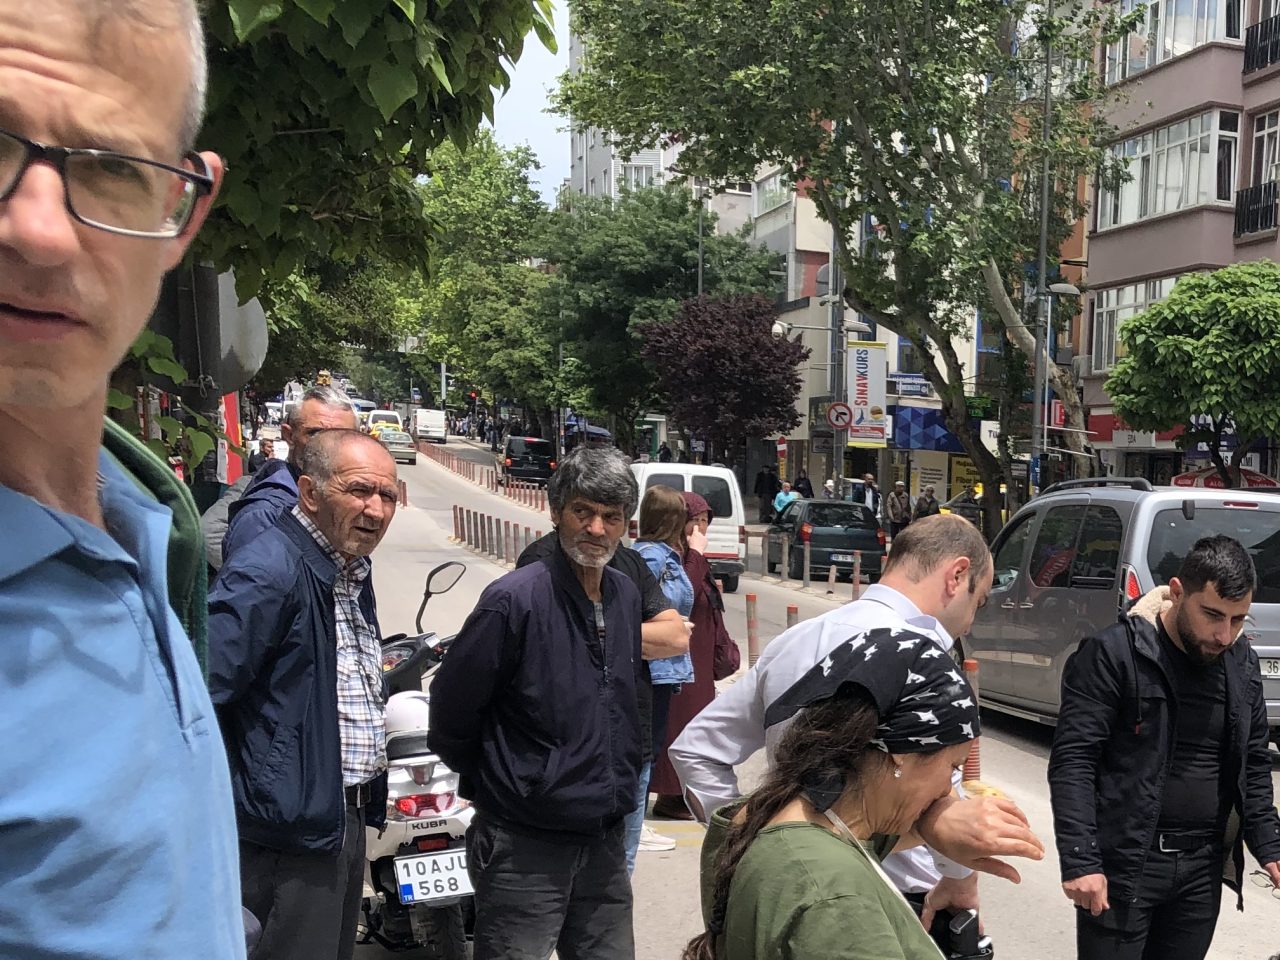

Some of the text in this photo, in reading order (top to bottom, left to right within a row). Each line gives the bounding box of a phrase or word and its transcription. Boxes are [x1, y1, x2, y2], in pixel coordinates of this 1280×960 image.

[1266, 660, 1279, 674] 36
[412, 820, 448, 830] KUBA
[418, 877, 459, 896] 568
